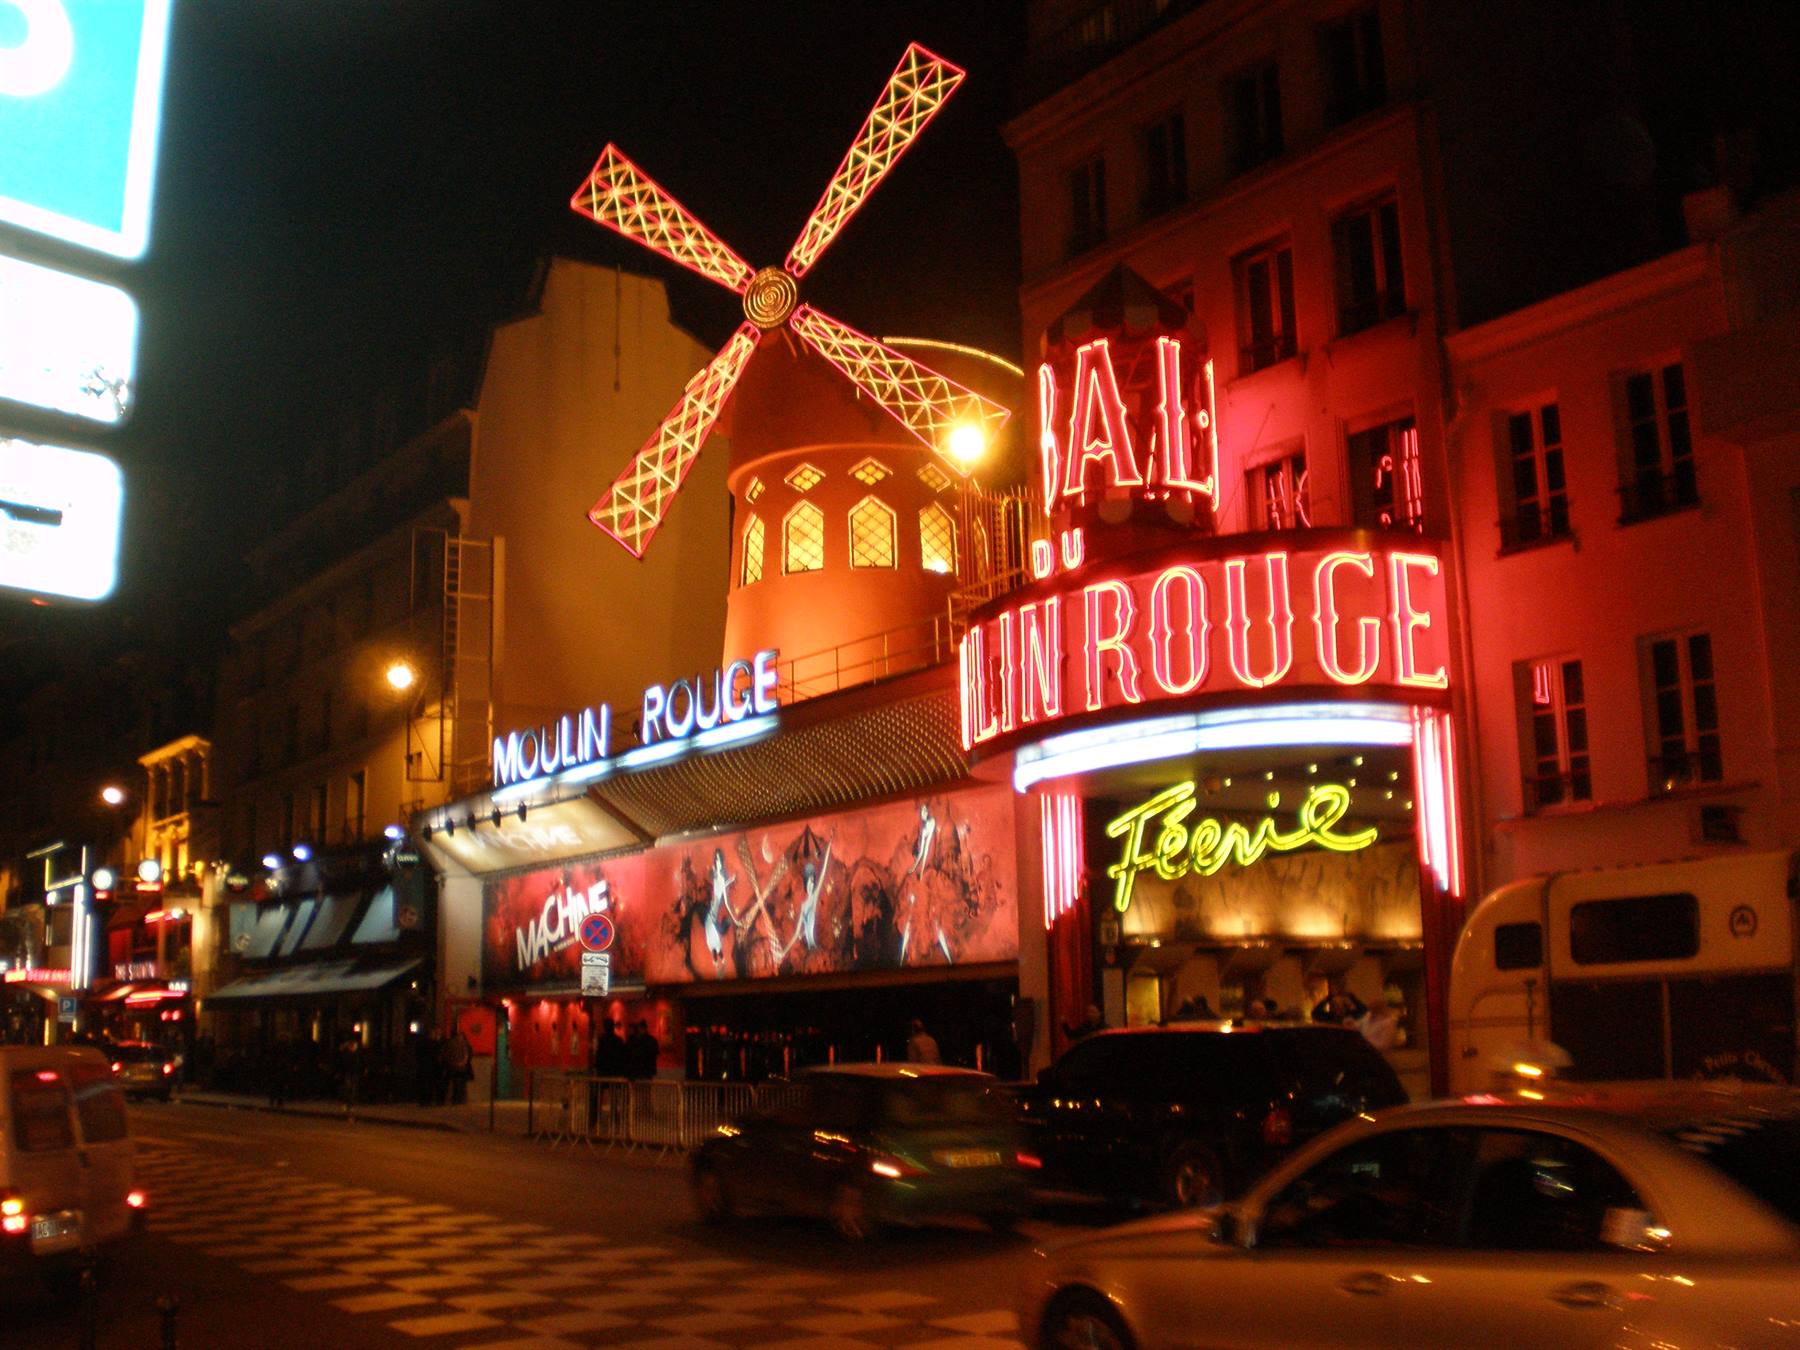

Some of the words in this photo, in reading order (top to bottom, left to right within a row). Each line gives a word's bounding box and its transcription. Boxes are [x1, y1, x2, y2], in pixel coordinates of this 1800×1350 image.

[1031, 528, 1085, 579] DU
[1084, 551, 1449, 711] ROUGE
[493, 703, 611, 787] MOULIN
[641, 649, 780, 744] ROUGE
[516, 879, 609, 971] MACHINE
[62, 1000, 71, 1012] P
